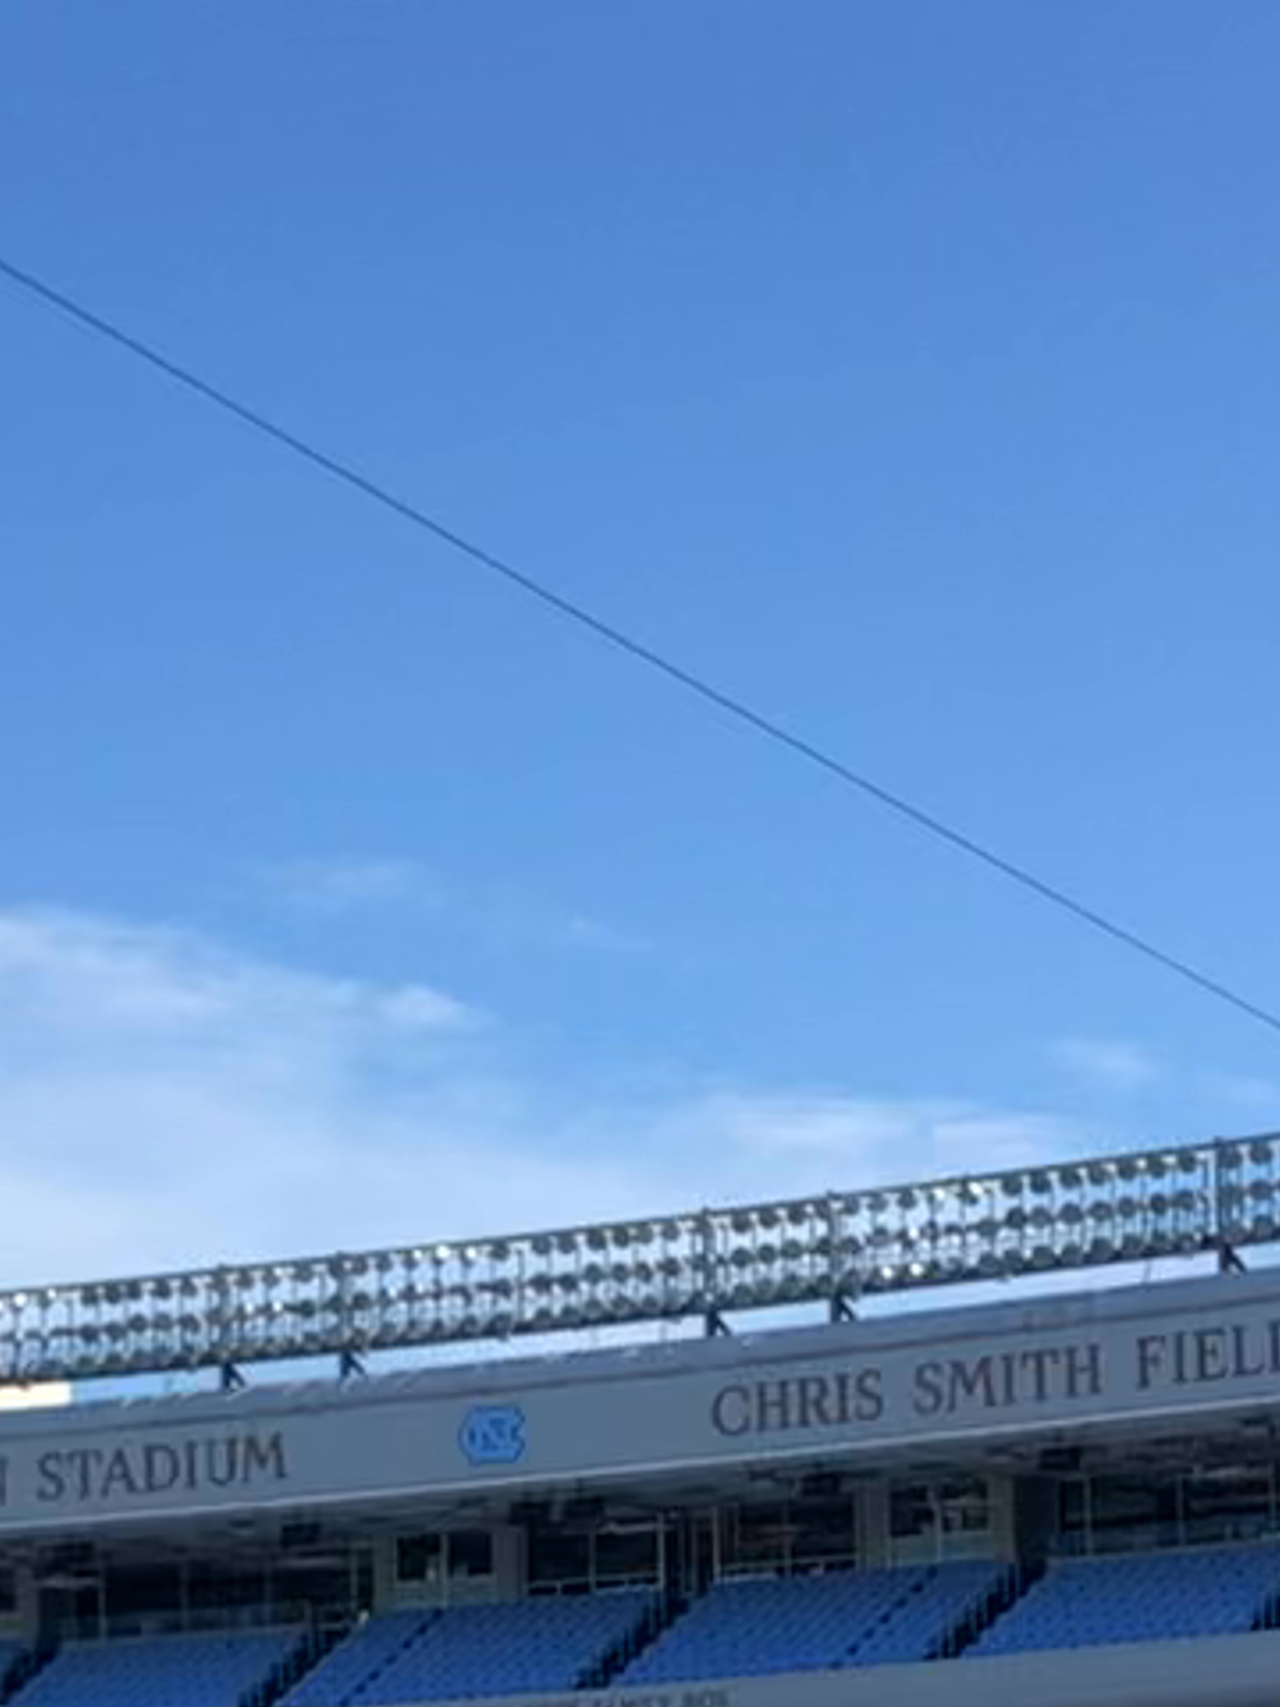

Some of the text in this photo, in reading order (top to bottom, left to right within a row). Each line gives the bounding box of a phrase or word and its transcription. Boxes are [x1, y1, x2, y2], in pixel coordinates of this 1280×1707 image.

[710, 1367, 885, 1436] CHRIS
[912, 1343, 1103, 1416] SMITH
[35, 1431, 288, 1501] STADIUM
